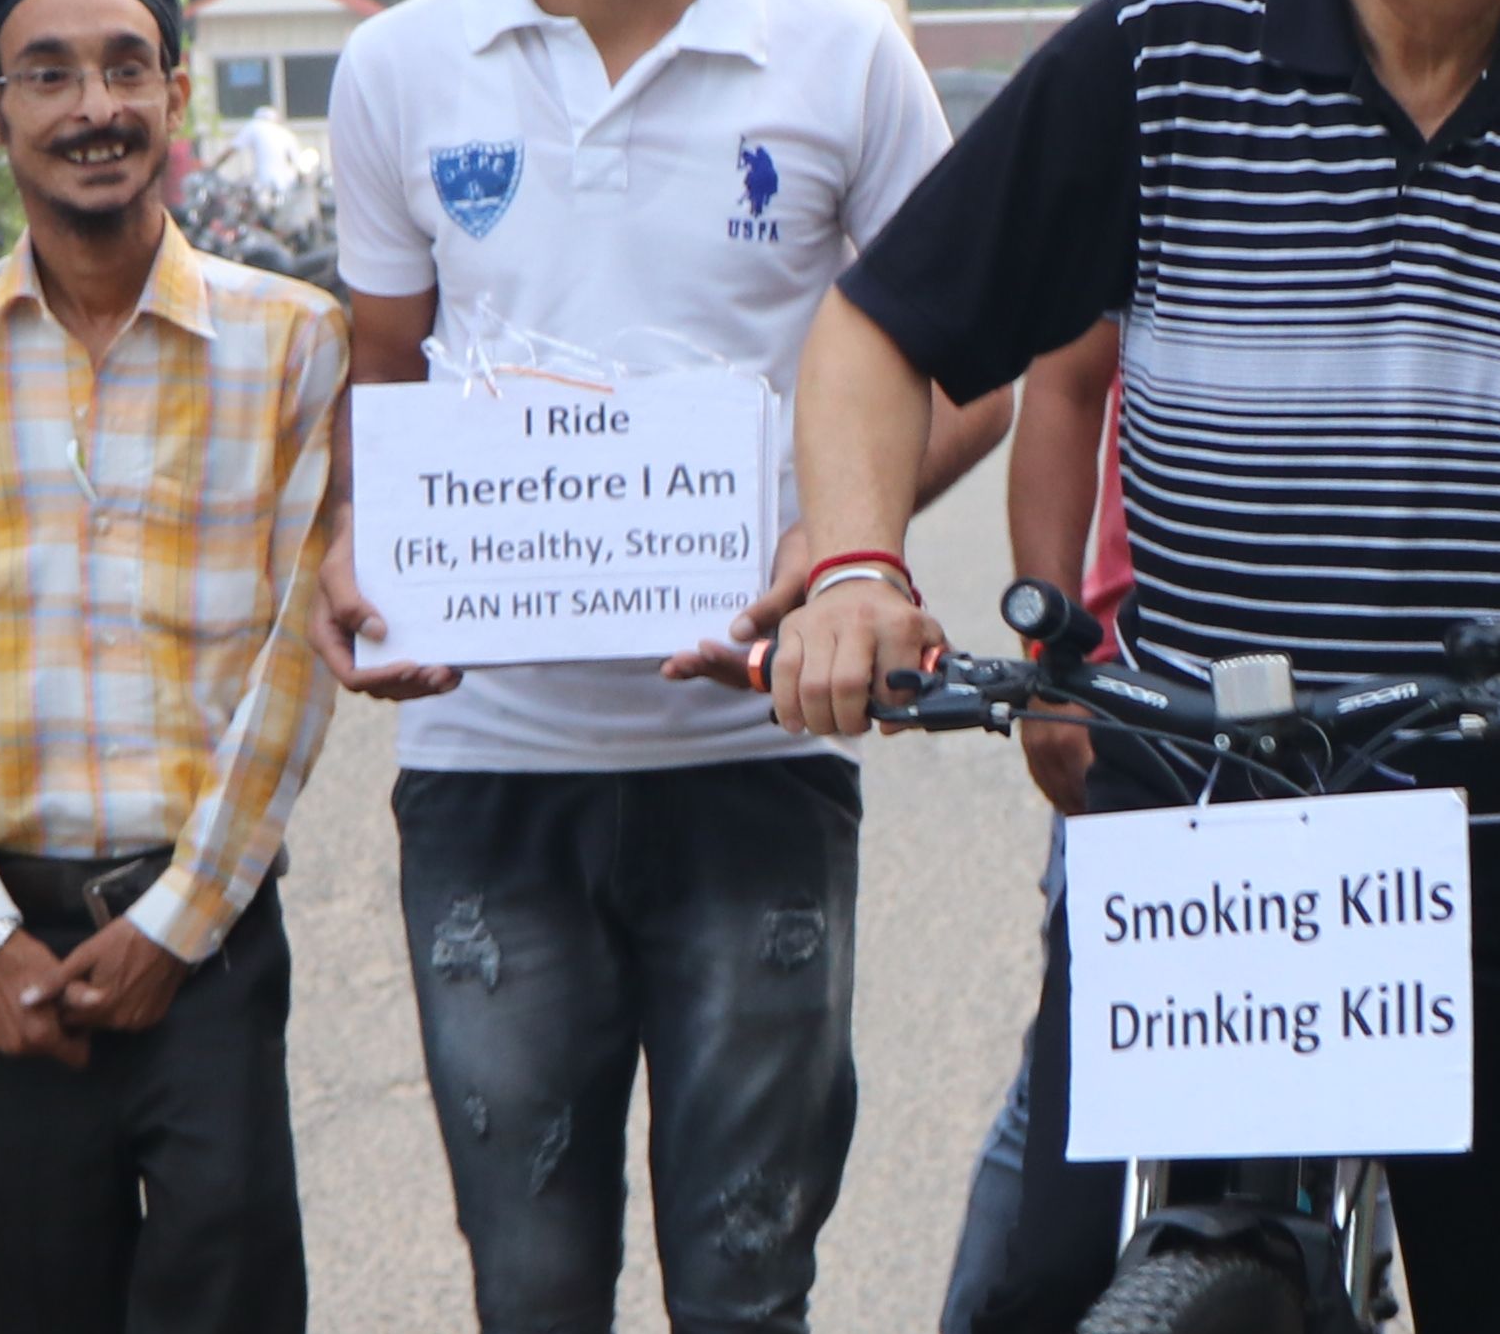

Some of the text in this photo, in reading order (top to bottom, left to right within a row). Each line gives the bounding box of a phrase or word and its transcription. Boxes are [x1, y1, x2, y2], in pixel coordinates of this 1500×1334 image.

[728, 218, 781, 243] USPA
[525, 403, 631, 437] I Ride
[419, 464, 736, 508] Therefore I Am
[393, 522, 751, 574] (Fit, Healthy, Strong)
[443, 593, 500, 622] JAN
[512, 591, 562, 618] HIT
[571, 585, 681, 617] SAMITI
[1104, 867, 1455, 943] Smoking Kills
[1109, 981, 1455, 1054] Drinking Kills
